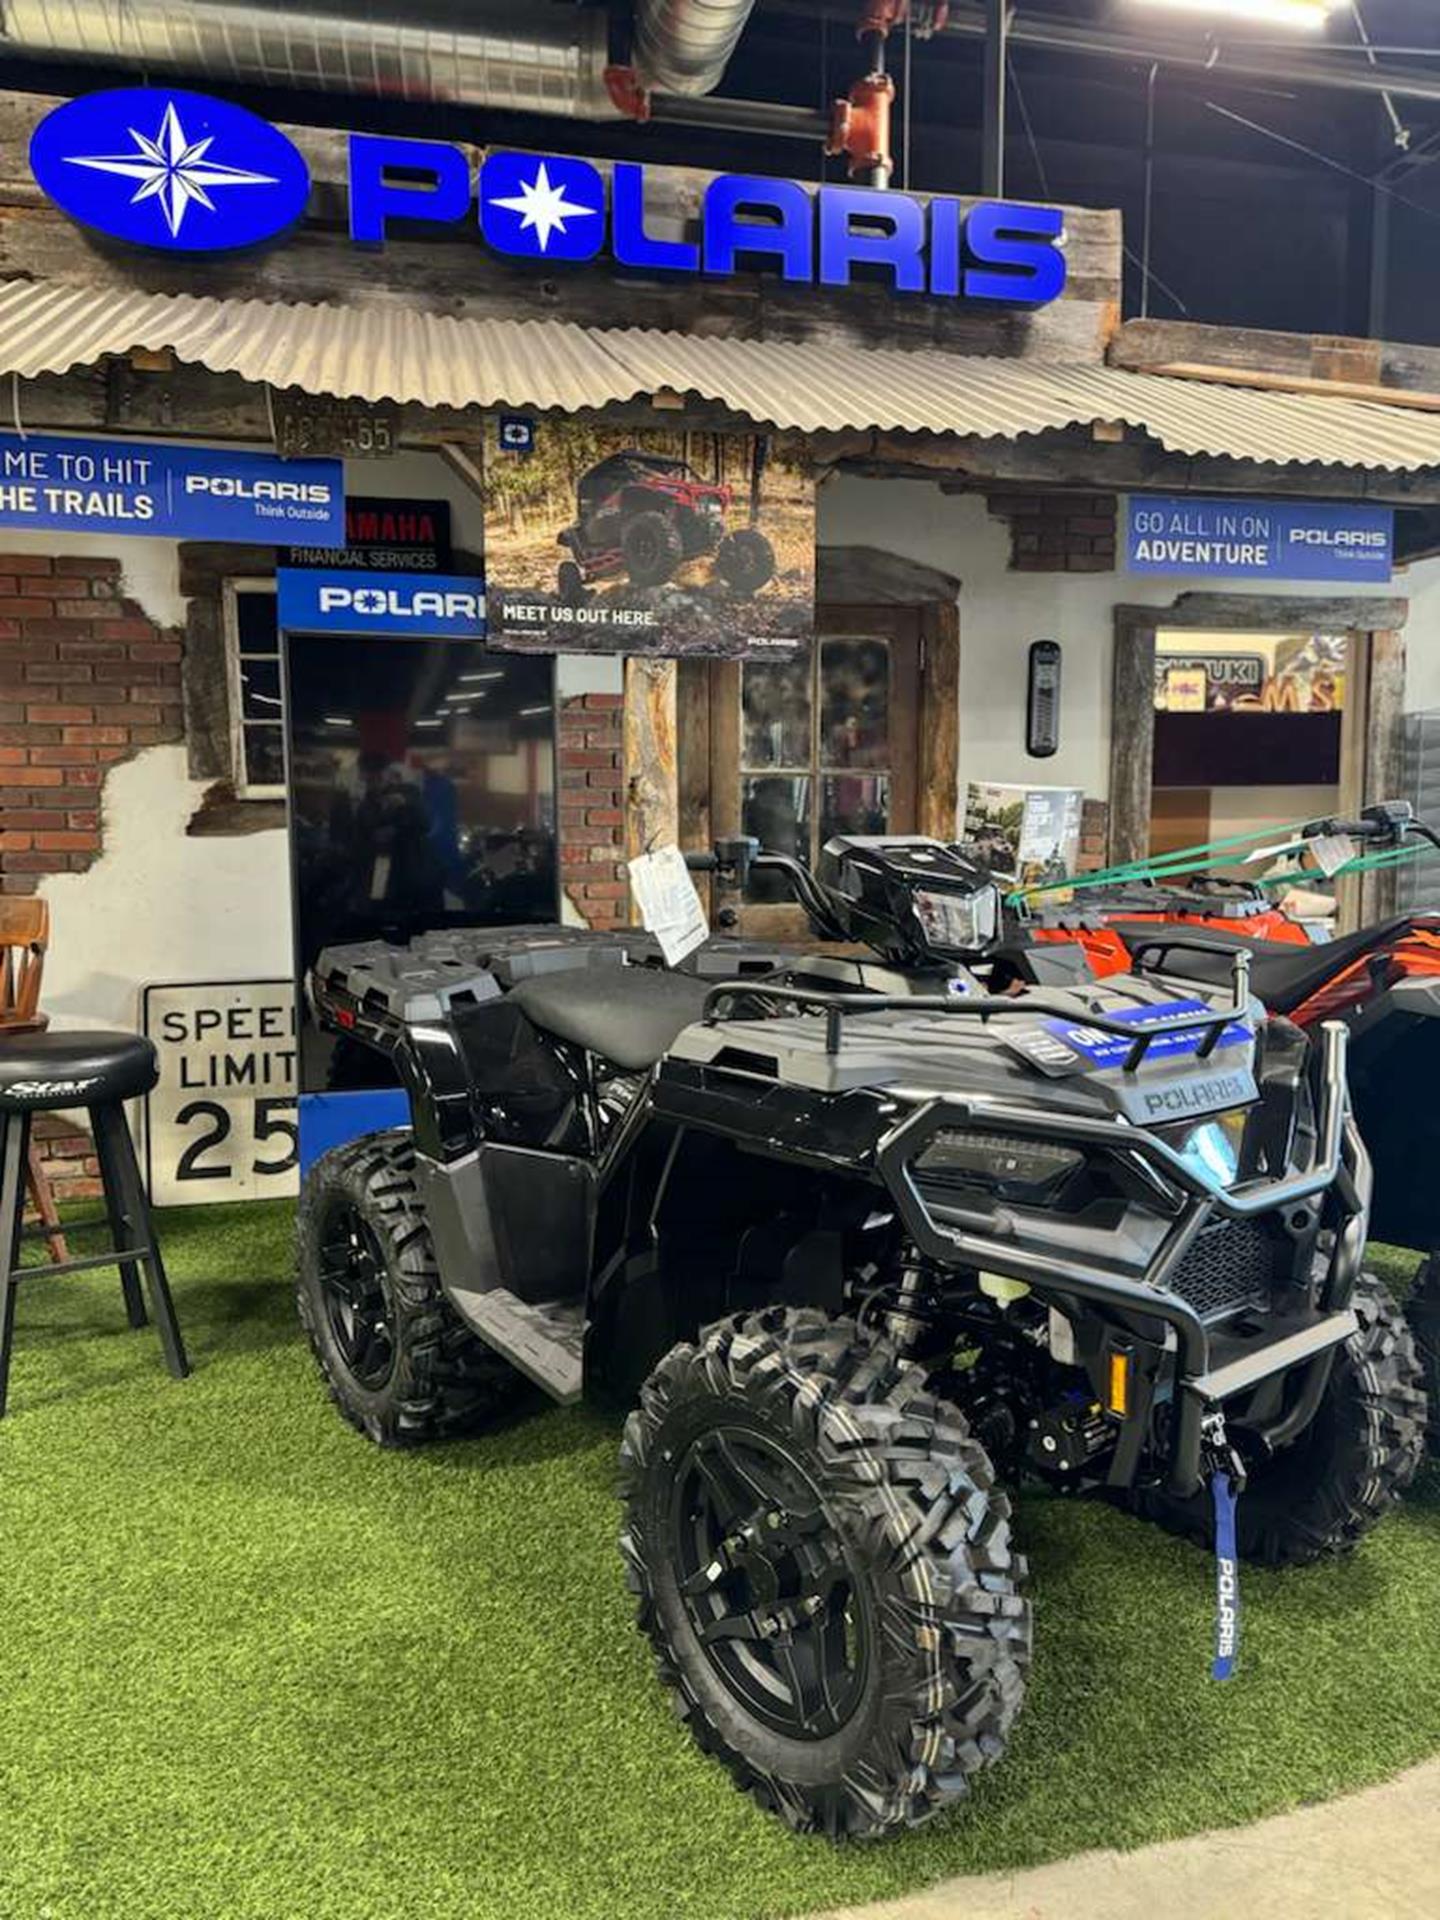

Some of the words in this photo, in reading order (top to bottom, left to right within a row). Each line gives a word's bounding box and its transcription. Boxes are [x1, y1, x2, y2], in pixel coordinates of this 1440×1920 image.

[349, 134, 1067, 308] POLARIS
[57, 454, 94, 482] TO
[103, 458, 152, 486] HIT
[43, 488, 153, 520] TRAILS
[185, 475, 331, 503] POLARIS
[255, 503, 286, 518] Think
[287, 506, 331, 521] Outside
[1135, 512, 1164, 533] GO
[1169, 514, 1210, 536] ALL
[1216, 516, 1237, 536] IN
[1241, 517, 1270, 538] ON
[1135, 540, 1269, 565] ADVENTURE
[1289, 528, 1387, 547] POLARIS
[290, 547, 369, 567] FINANCIAL
[369, 552, 438, 569] SERVICES
[502, 604, 548, 621] MEET
[551, 607, 573, 622] US
[575, 608, 608, 623] OUT
[612, 609, 660, 626] HERE.
[181, 1051, 297, 1088] LIMIT
[1144, 1076, 1244, 1115] POLARIS
[175, 1097, 299, 1181] 25
[1219, 1557, 1235, 1657] POLARIS
